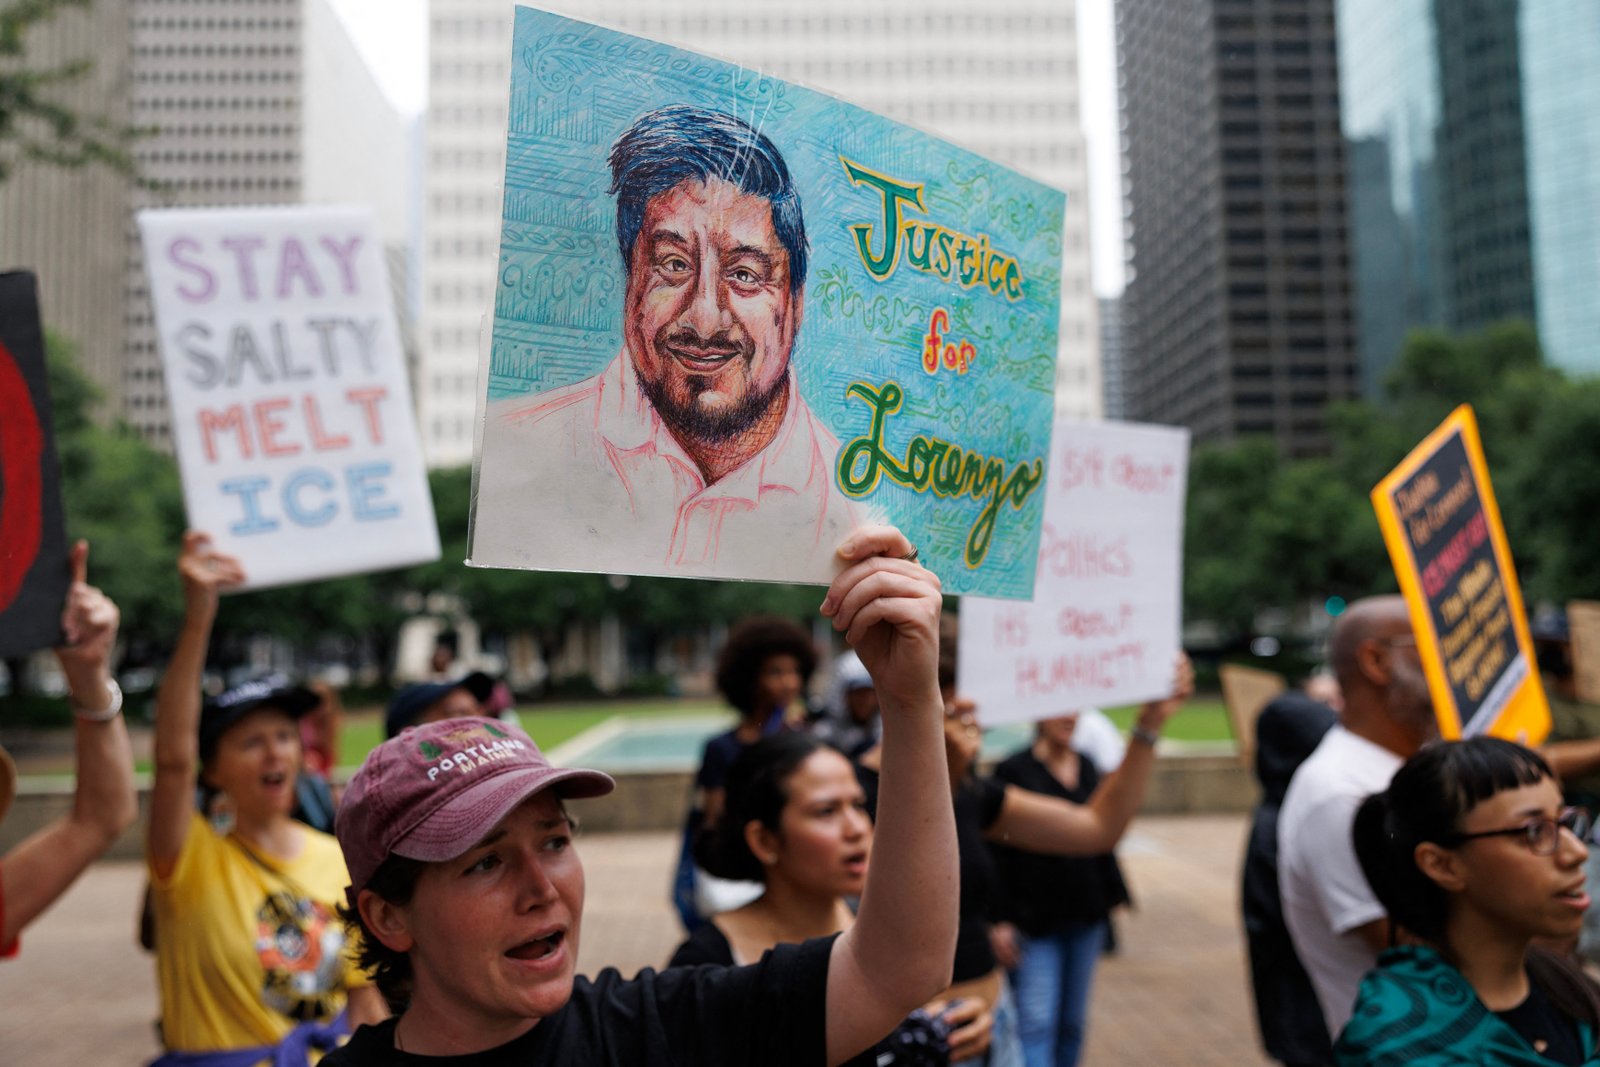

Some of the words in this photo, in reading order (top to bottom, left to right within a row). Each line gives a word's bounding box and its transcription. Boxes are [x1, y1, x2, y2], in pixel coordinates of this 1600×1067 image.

[840, 156, 1024, 301] Justice
[167, 234, 365, 302] STAY
[175, 317, 381, 389] SALTY
[922, 308, 976, 375] for
[197, 386, 389, 464] MELT
[219, 462, 400, 536] ICE
[836, 380, 1043, 569] Lorenzo
[427, 739, 525, 781] PORTLAND
[459, 748, 517, 774] MAINE
